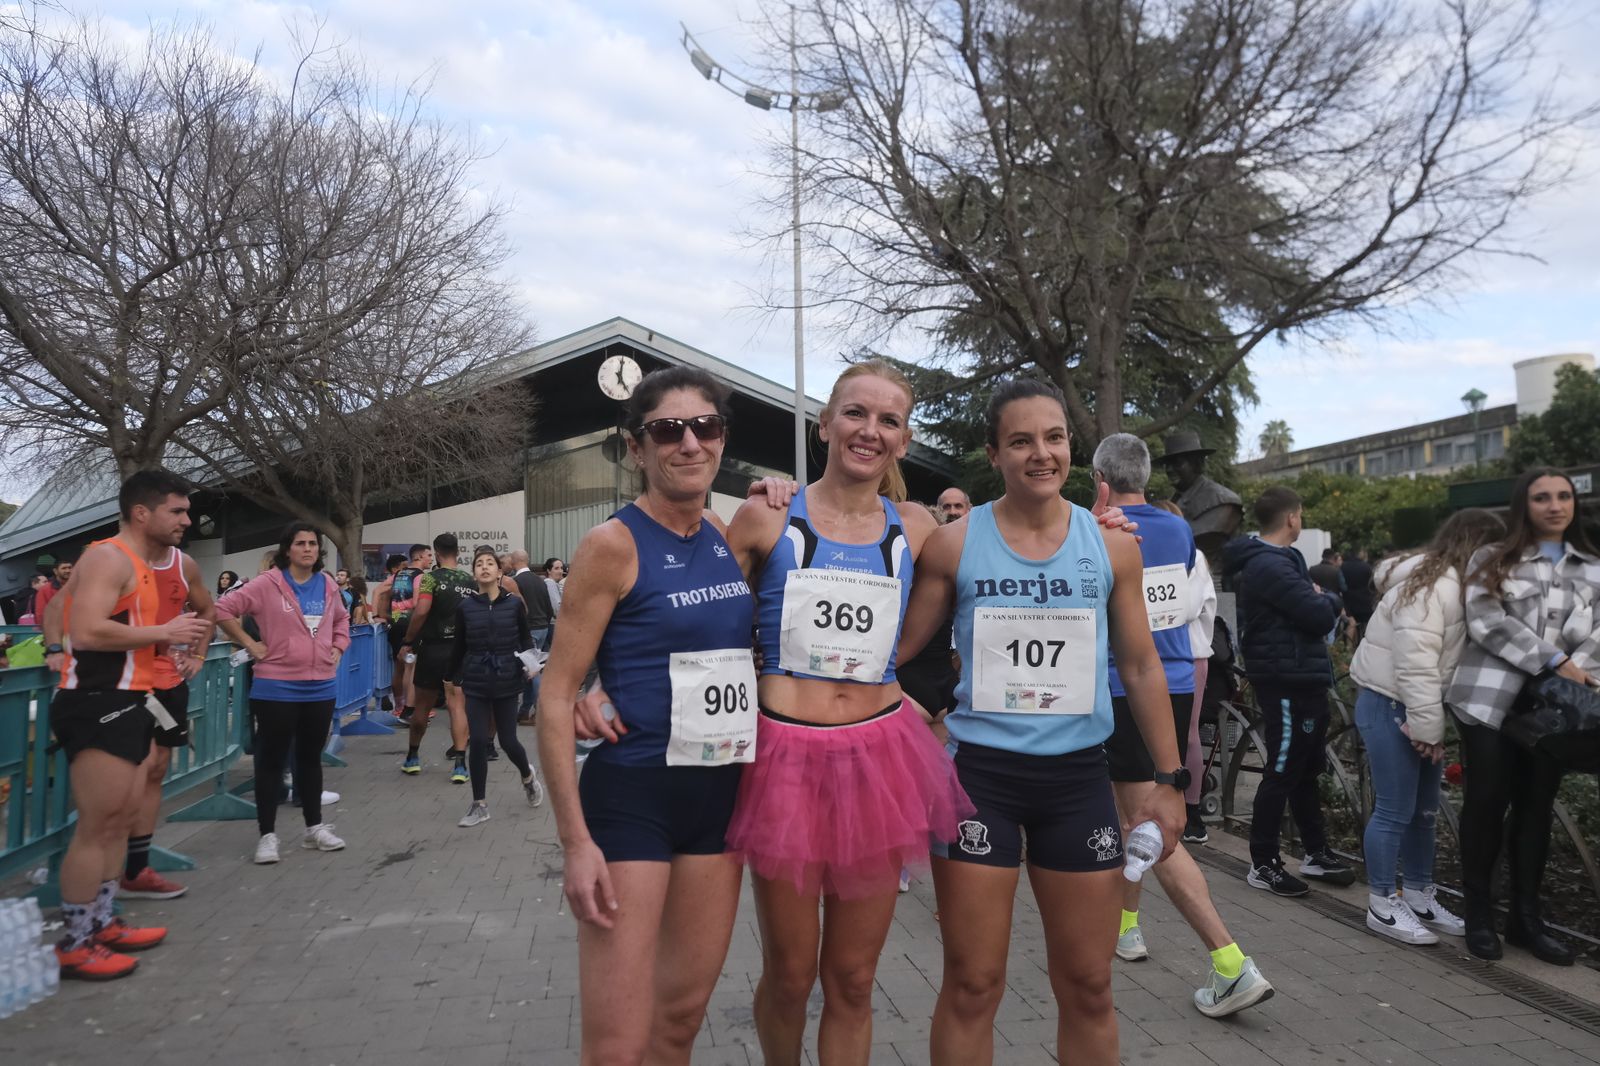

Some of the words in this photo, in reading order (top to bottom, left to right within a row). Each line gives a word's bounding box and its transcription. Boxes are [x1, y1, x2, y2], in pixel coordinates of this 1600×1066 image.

[820, 574, 857, 584] SILVESTRE
[974, 572, 1073, 604] nerja
[1146, 583, 1177, 603] 832
[813, 600, 874, 634] 369
[1005, 639, 1066, 668] 107
[704, 682, 749, 716] 908
